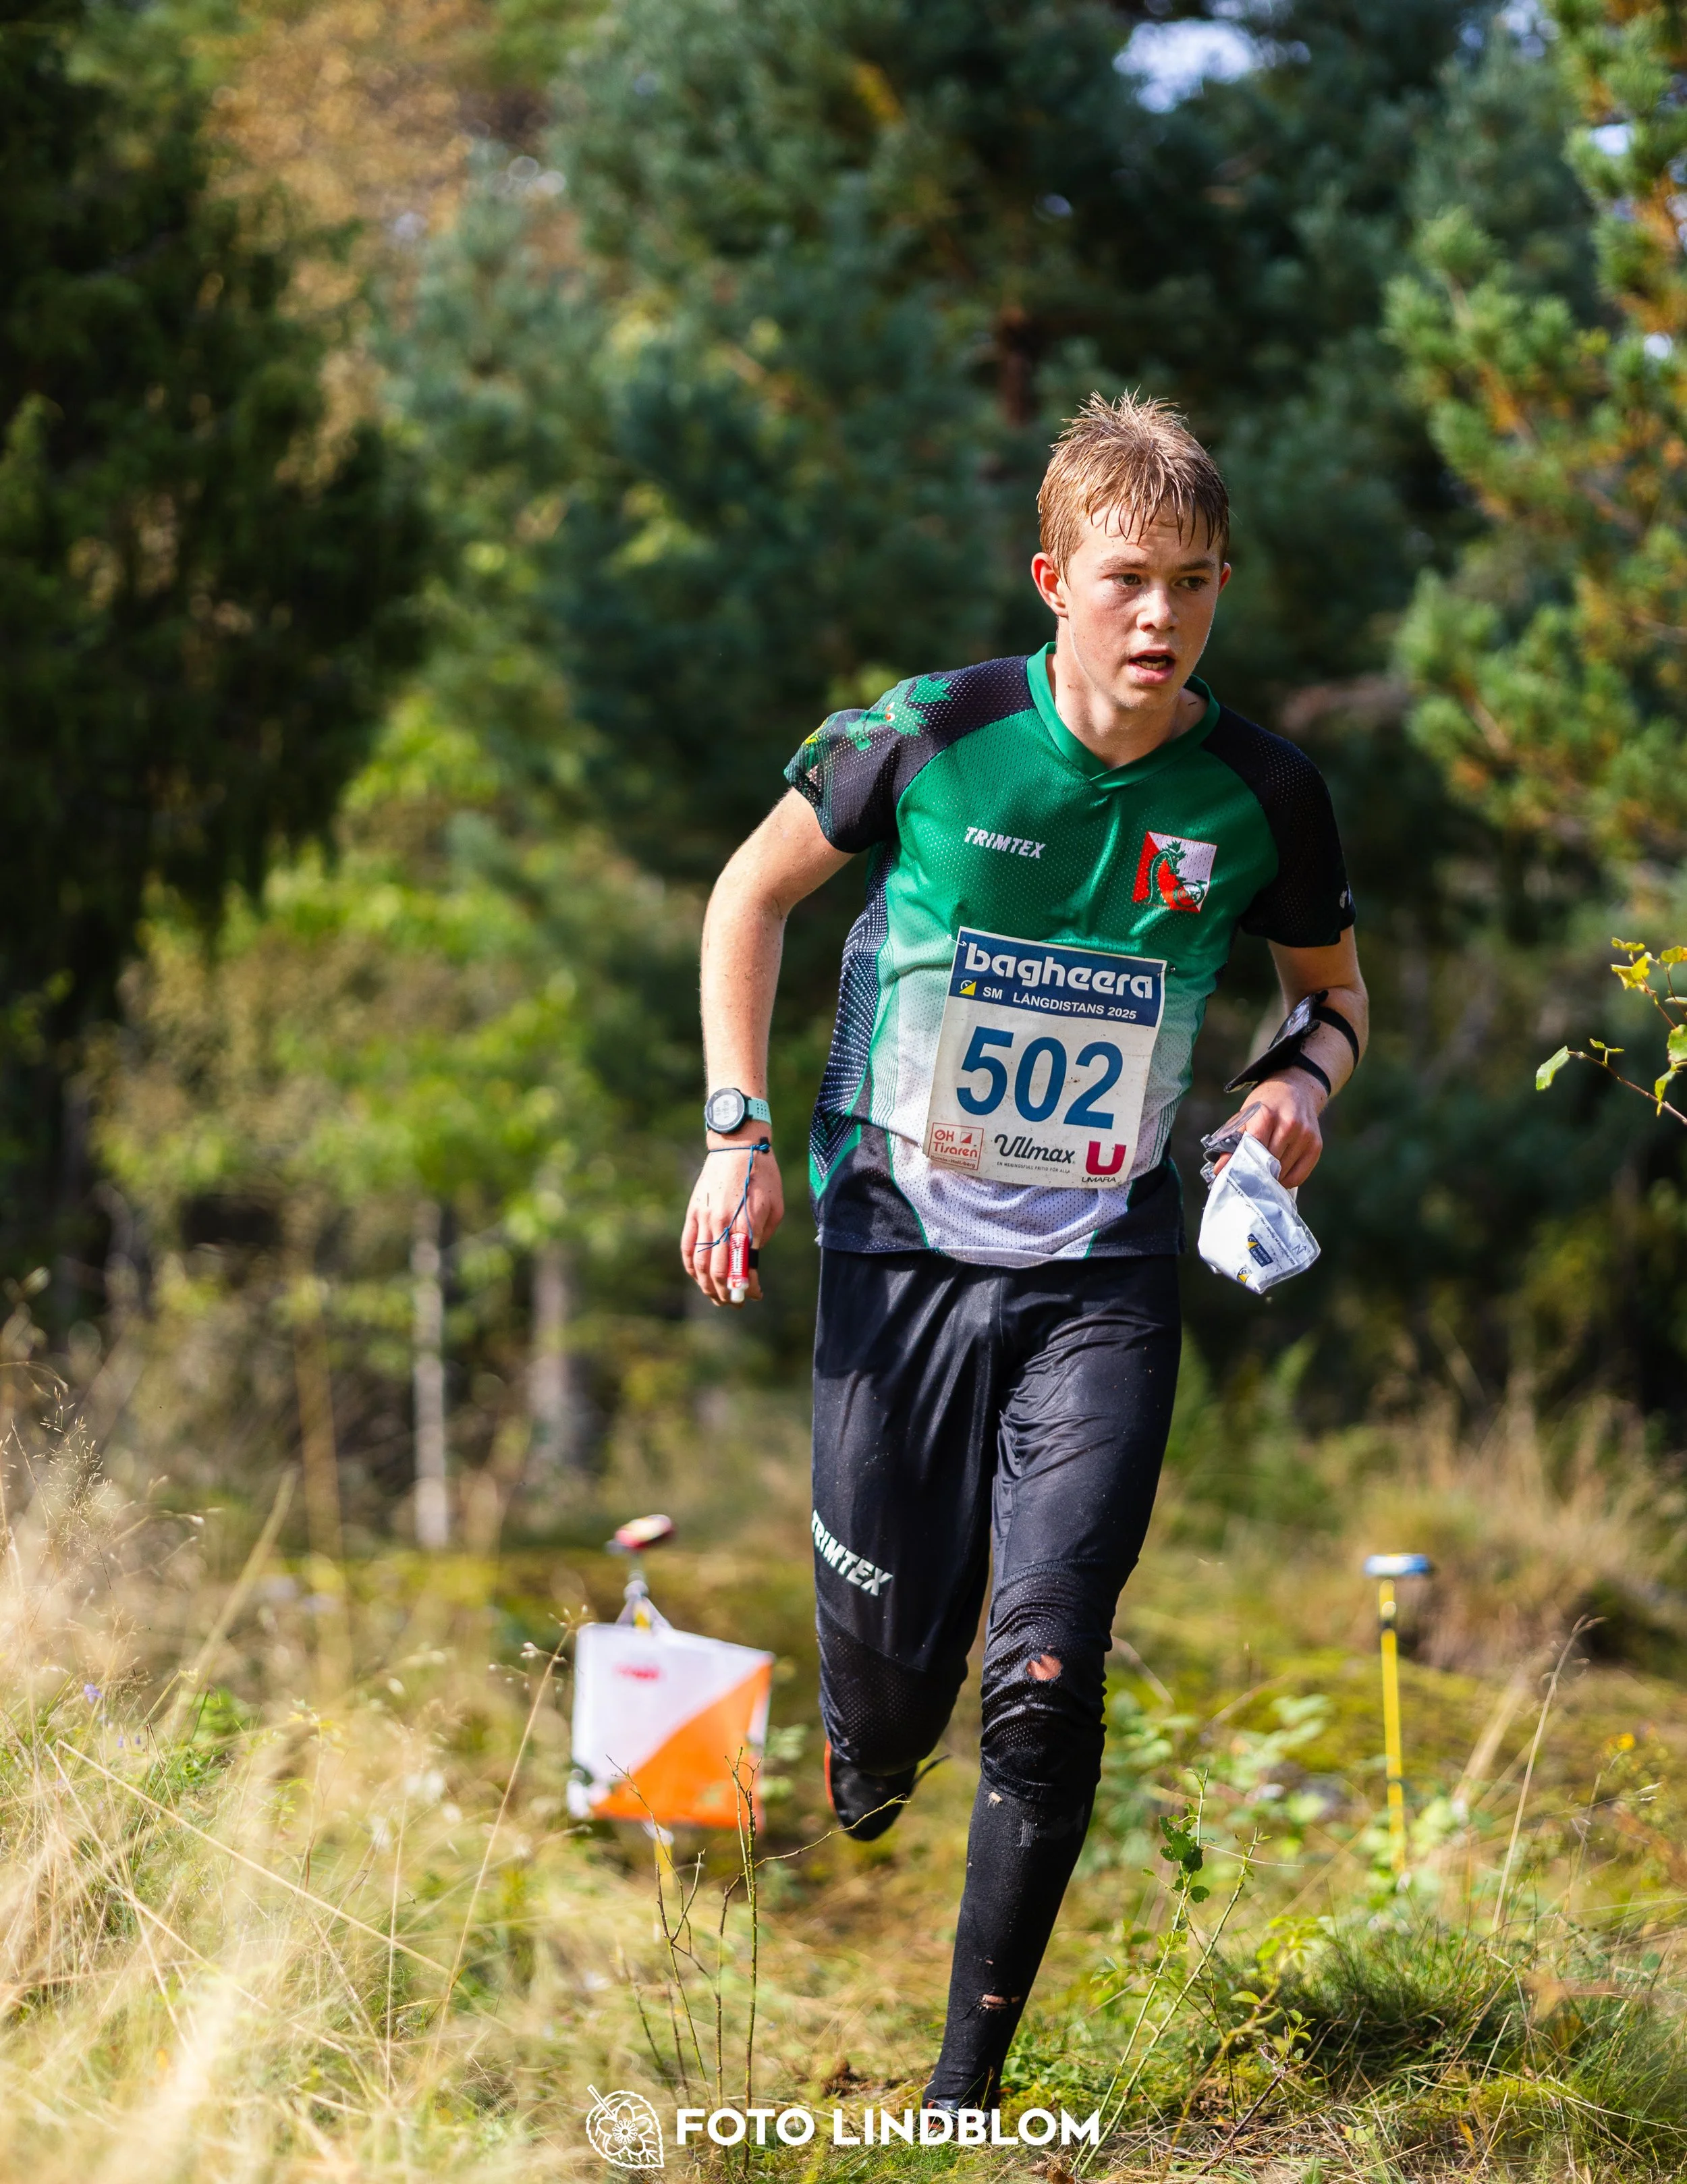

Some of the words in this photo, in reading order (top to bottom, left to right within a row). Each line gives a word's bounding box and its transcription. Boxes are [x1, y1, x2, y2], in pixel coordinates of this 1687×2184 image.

[964, 826, 1047, 858] TRIMTEX
[965, 943, 1153, 1000] bagheera
[983, 986, 1003, 1000] SM
[1013, 993, 1105, 1015] LÅNGDISTANS
[1107, 1006, 1137, 1020] 2025
[956, 1025, 1124, 1130] 502
[933, 1141, 978, 1158] Tisaren
[994, 1134, 1076, 1164] Ullmax
[1250, 1247, 1264, 1264] League
[1255, 1245, 1271, 1263] Swedish
[812, 1509, 893, 1596] TRIMTEX
